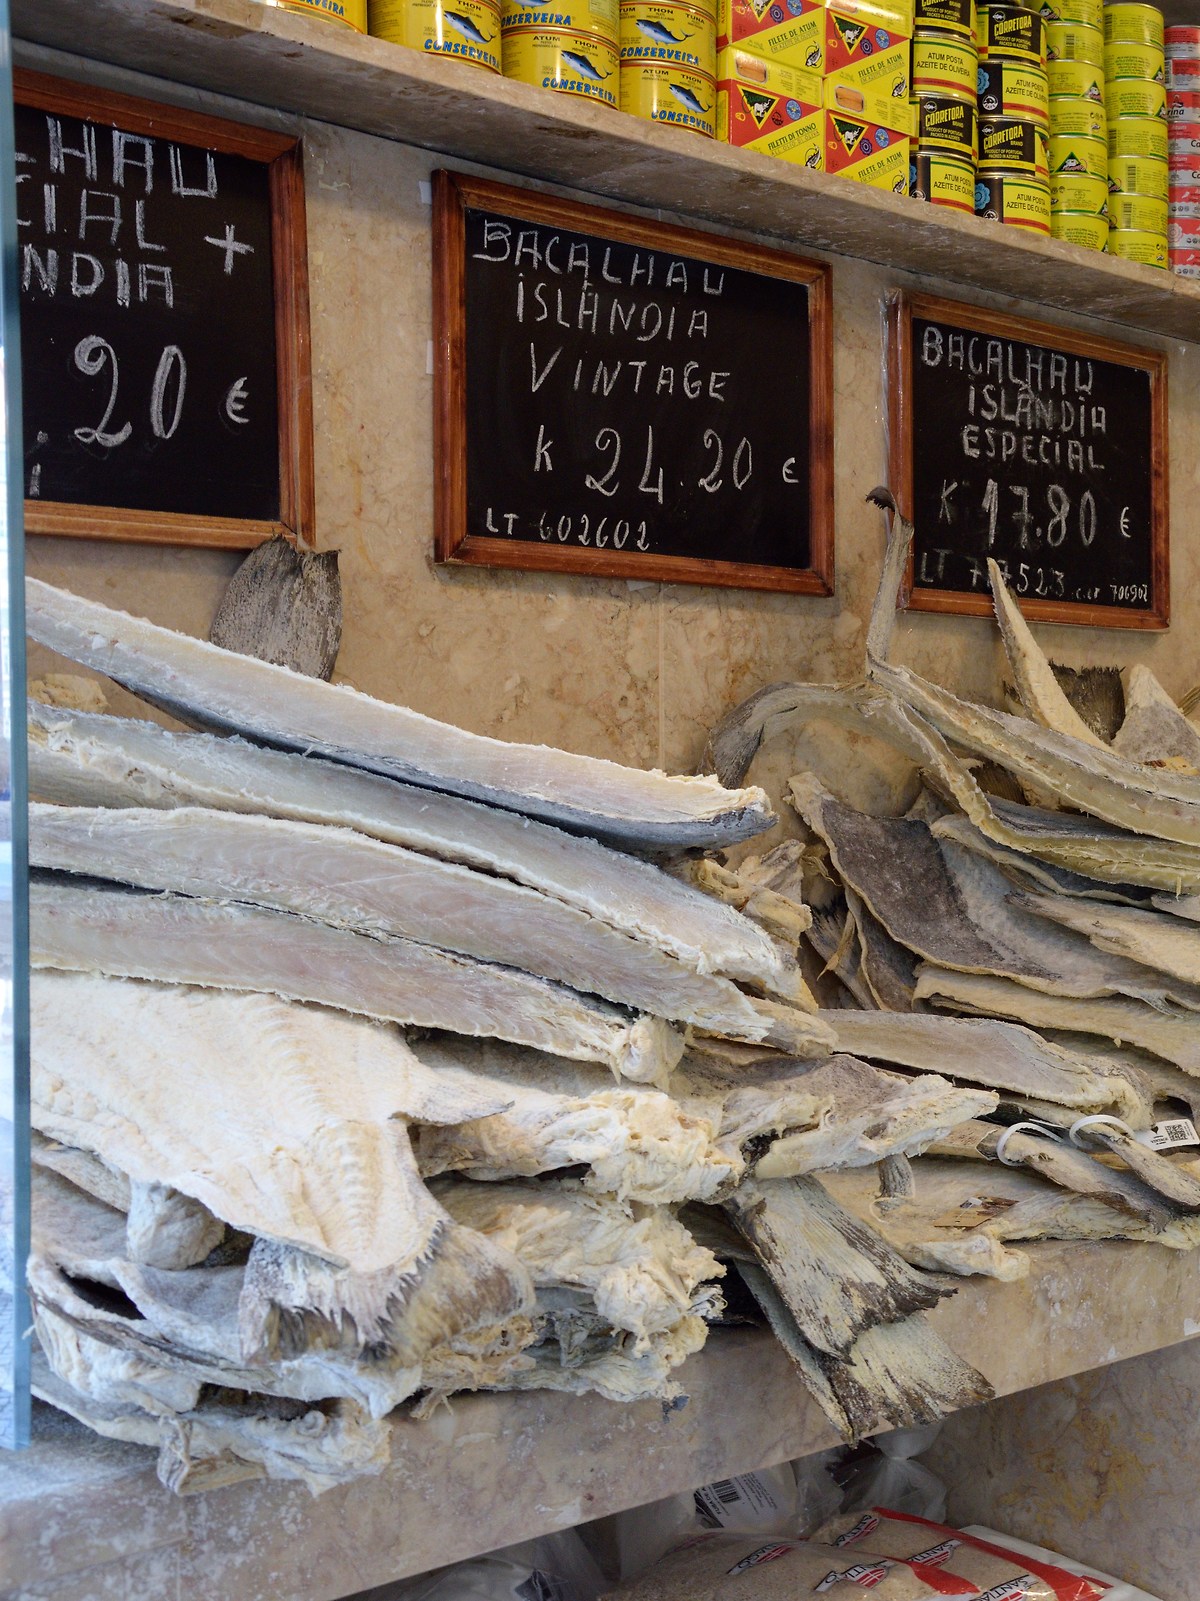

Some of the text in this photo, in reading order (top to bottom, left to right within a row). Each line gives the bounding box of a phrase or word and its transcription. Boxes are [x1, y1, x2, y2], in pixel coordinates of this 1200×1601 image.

[457, 0, 481, 11] THON
[685, 13, 705, 24] TUNA
[994, 15, 1032, 36] CORRETORA
[768, 20, 817, 47] FILETE DE ATUM
[574, 39, 598, 50] THON
[621, 46, 699, 65] CONSERVEIRA
[857, 53, 903, 79] FILETE DE ATUM
[927, 52, 963, 65] ATUM POSTA
[680, 74, 702, 84] THON
[916, 61, 970, 77] AZEITE DE OLIVEIRA
[1005, 87, 1025, 96] AZEITE
[1015, 80, 1031, 88] ATUM
[925, 105, 964, 127] CORRETORA
[767, 123, 817, 150] FILETTI DI TONNO
[984, 125, 1024, 150] CORRETORA
[857, 151, 903, 179] FILETE DE ATUM
[933, 181, 961, 192] AZEITE DE
[944, 173, 959, 182] ATUM
[1006, 201, 1026, 209] AZEITE
[1016, 193, 1032, 201] ATUM
[472, 219, 725, 297] BACALHAU
[921, 326, 1094, 396] BACALHAU
[530, 342, 731, 402] VINTAGE
[226, 377, 249, 425] €
[961, 424, 1105, 474] ESPECIAL
[585, 424, 753, 505] 24.20
[782, 457, 800, 484] €
[938, 478, 1131, 550] K 17.80 €
[485, 507, 650, 552] LT 602602
